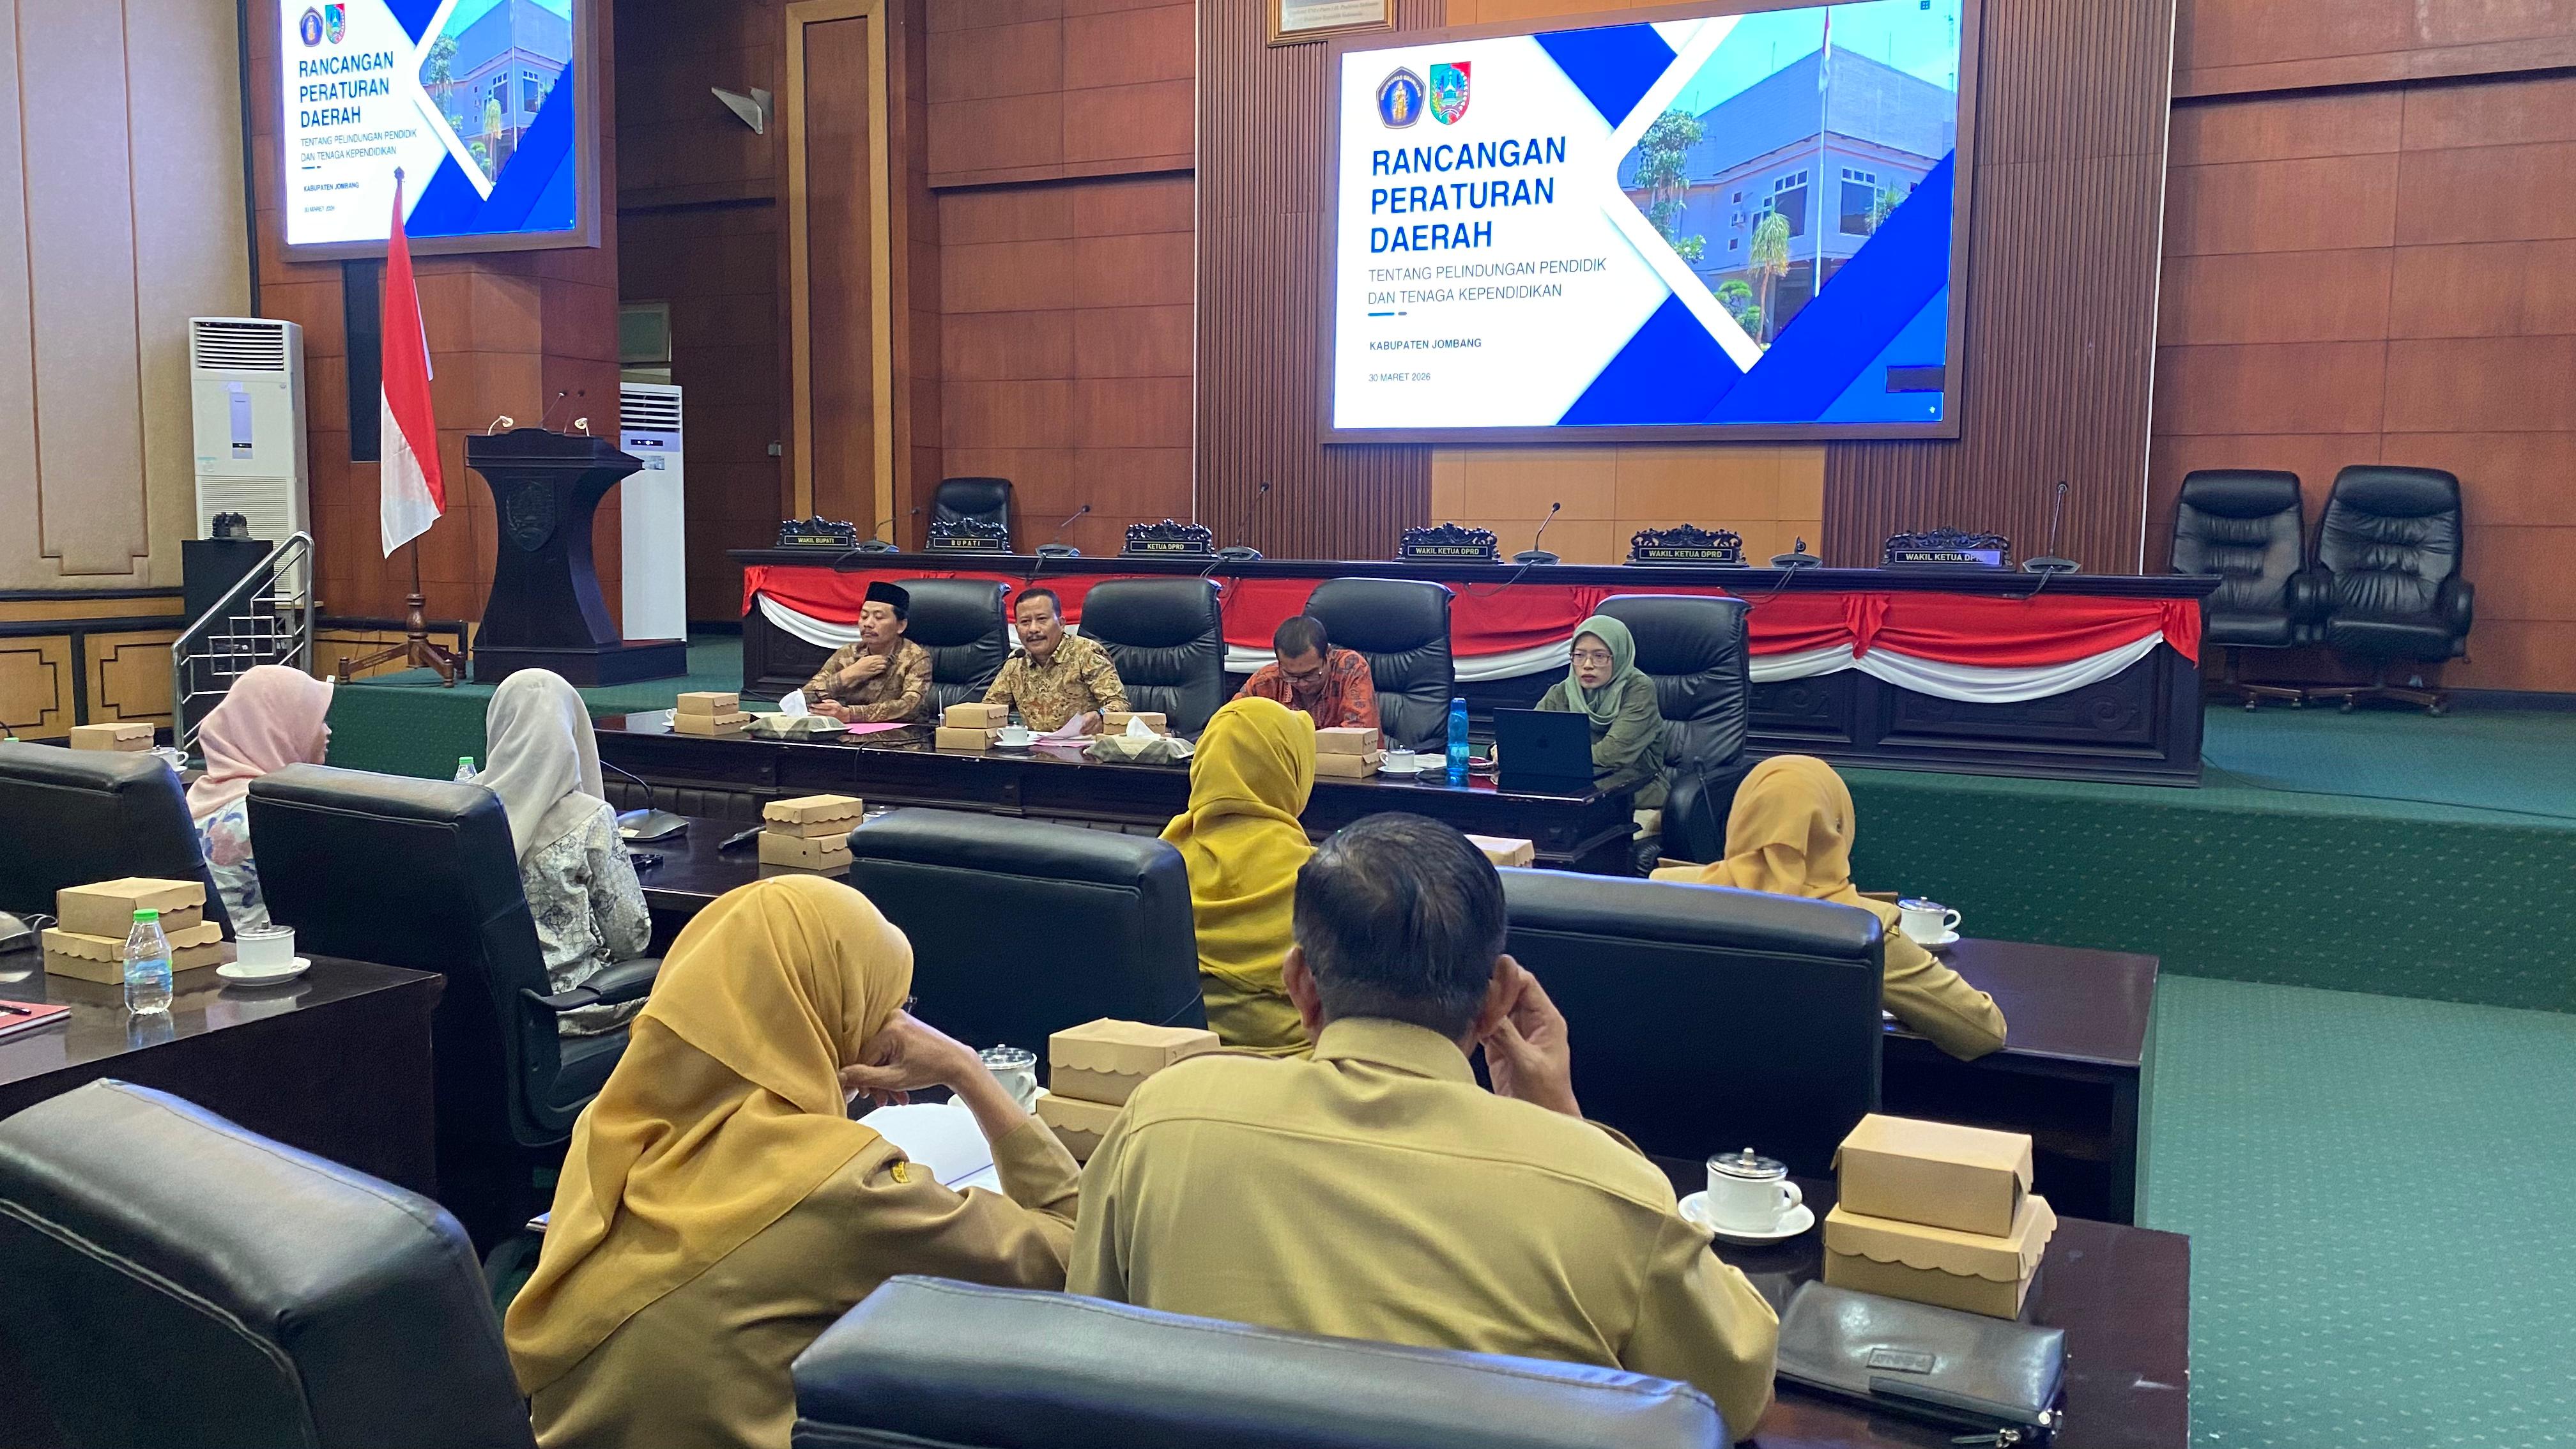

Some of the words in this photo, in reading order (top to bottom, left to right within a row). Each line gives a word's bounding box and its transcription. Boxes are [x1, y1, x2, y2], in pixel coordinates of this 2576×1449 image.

[299, 50, 394, 78] RANCANGAN
[300, 77, 389, 103] PERATURAN
[300, 105, 361, 128] DAERAH
[300, 135, 332, 147] TENTANG
[334, 132, 383, 144] PELINDUNGAN
[384, 128, 417, 140] PENDIDIK
[301, 153, 316, 162] DAN
[316, 150, 344, 160] TENAGA
[346, 146, 397, 158] KEPENDIDIKAN
[1372, 135, 1565, 176] RANCANGAN
[303, 183, 334, 192] KABUPATEN
[334, 181, 359, 190] JOMBANG
[1372, 177, 1554, 215] PERATURAN
[1370, 220, 1492, 254] DAERAH
[1368, 266, 1432, 282] TENTANG
[1436, 261, 1535, 279] PELINDUNGAN
[1540, 257, 1607, 274] PENDIDIK
[1368, 291, 1395, 305] DAN
[1399, 288, 1455, 303] TENAGA
[1459, 284, 1561, 301] KEPENDIDIKAN
[1370, 339, 1429, 351] KABUPATEN
[1432, 338, 1482, 349] JOMBANG
[1368, 373, 1378, 382] 30
[1380, 372, 1410, 381] MARET
[1411, 372, 1431, 381] 2026
